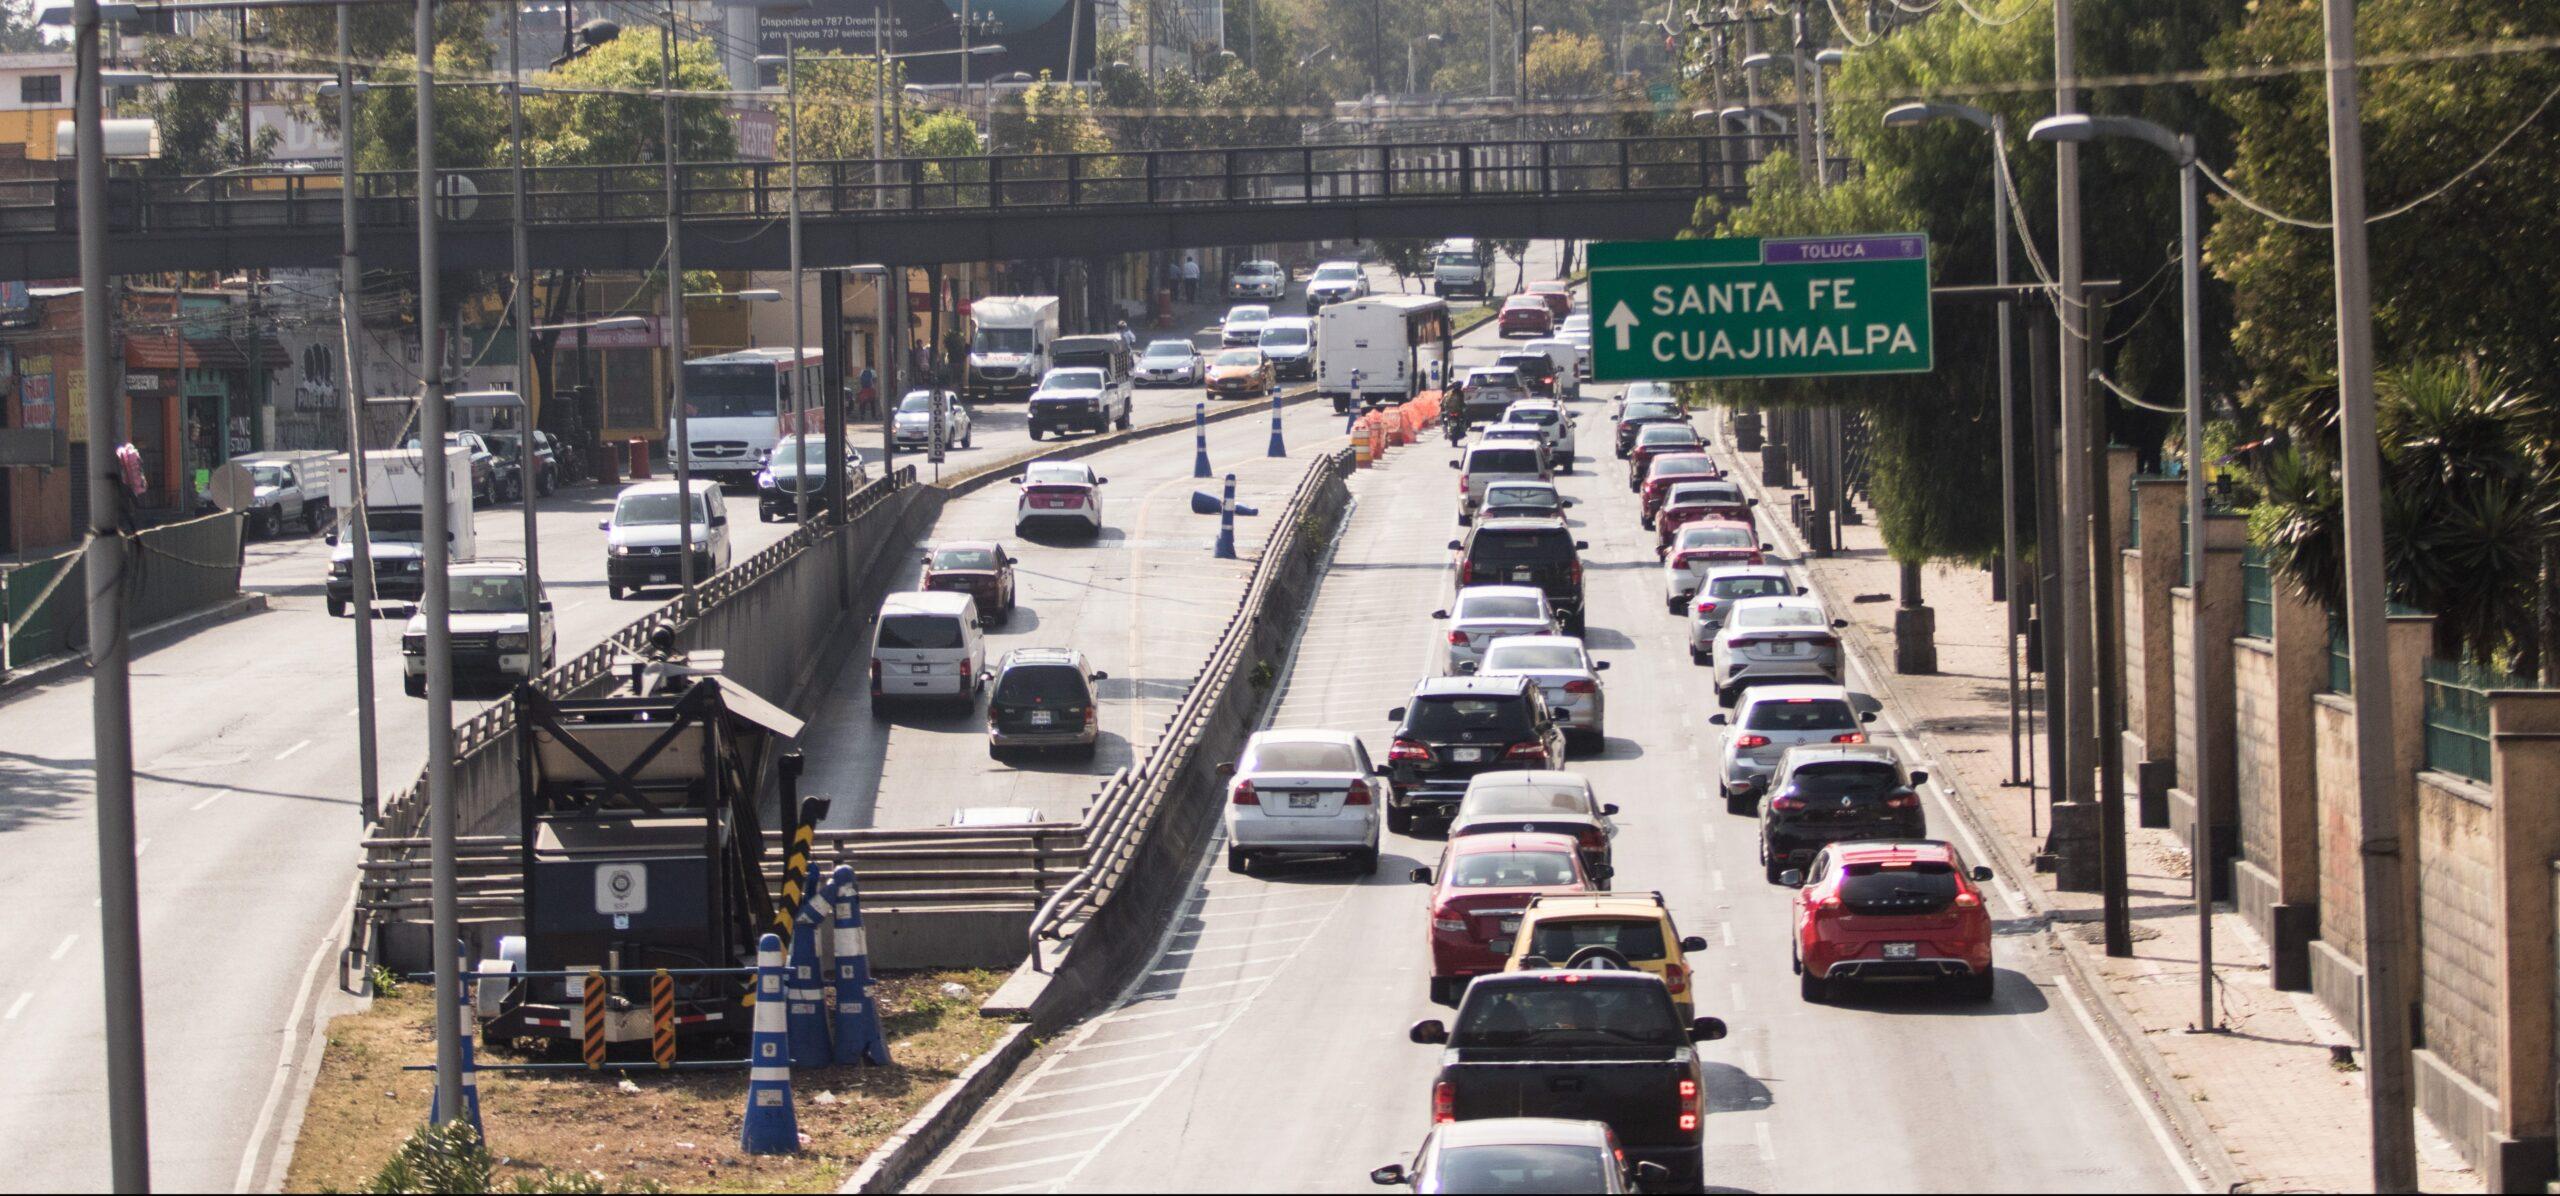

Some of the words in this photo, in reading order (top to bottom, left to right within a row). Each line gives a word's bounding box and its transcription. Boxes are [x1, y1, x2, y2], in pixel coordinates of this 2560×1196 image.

[761, 17, 810, 28] Disponible
[825, 17, 842, 26] 787
[762, 31, 768, 40] y
[769, 31, 781, 39] en
[822, 30, 839, 39] 737
[1801, 243, 1866, 258] TOLUCA
[1651, 281, 1784, 316] SANTA
[1807, 278, 1857, 310] FE
[1651, 323, 1918, 362] CUAJIMALPA
[933, 390, 943, 457] AUTOLAVADO
